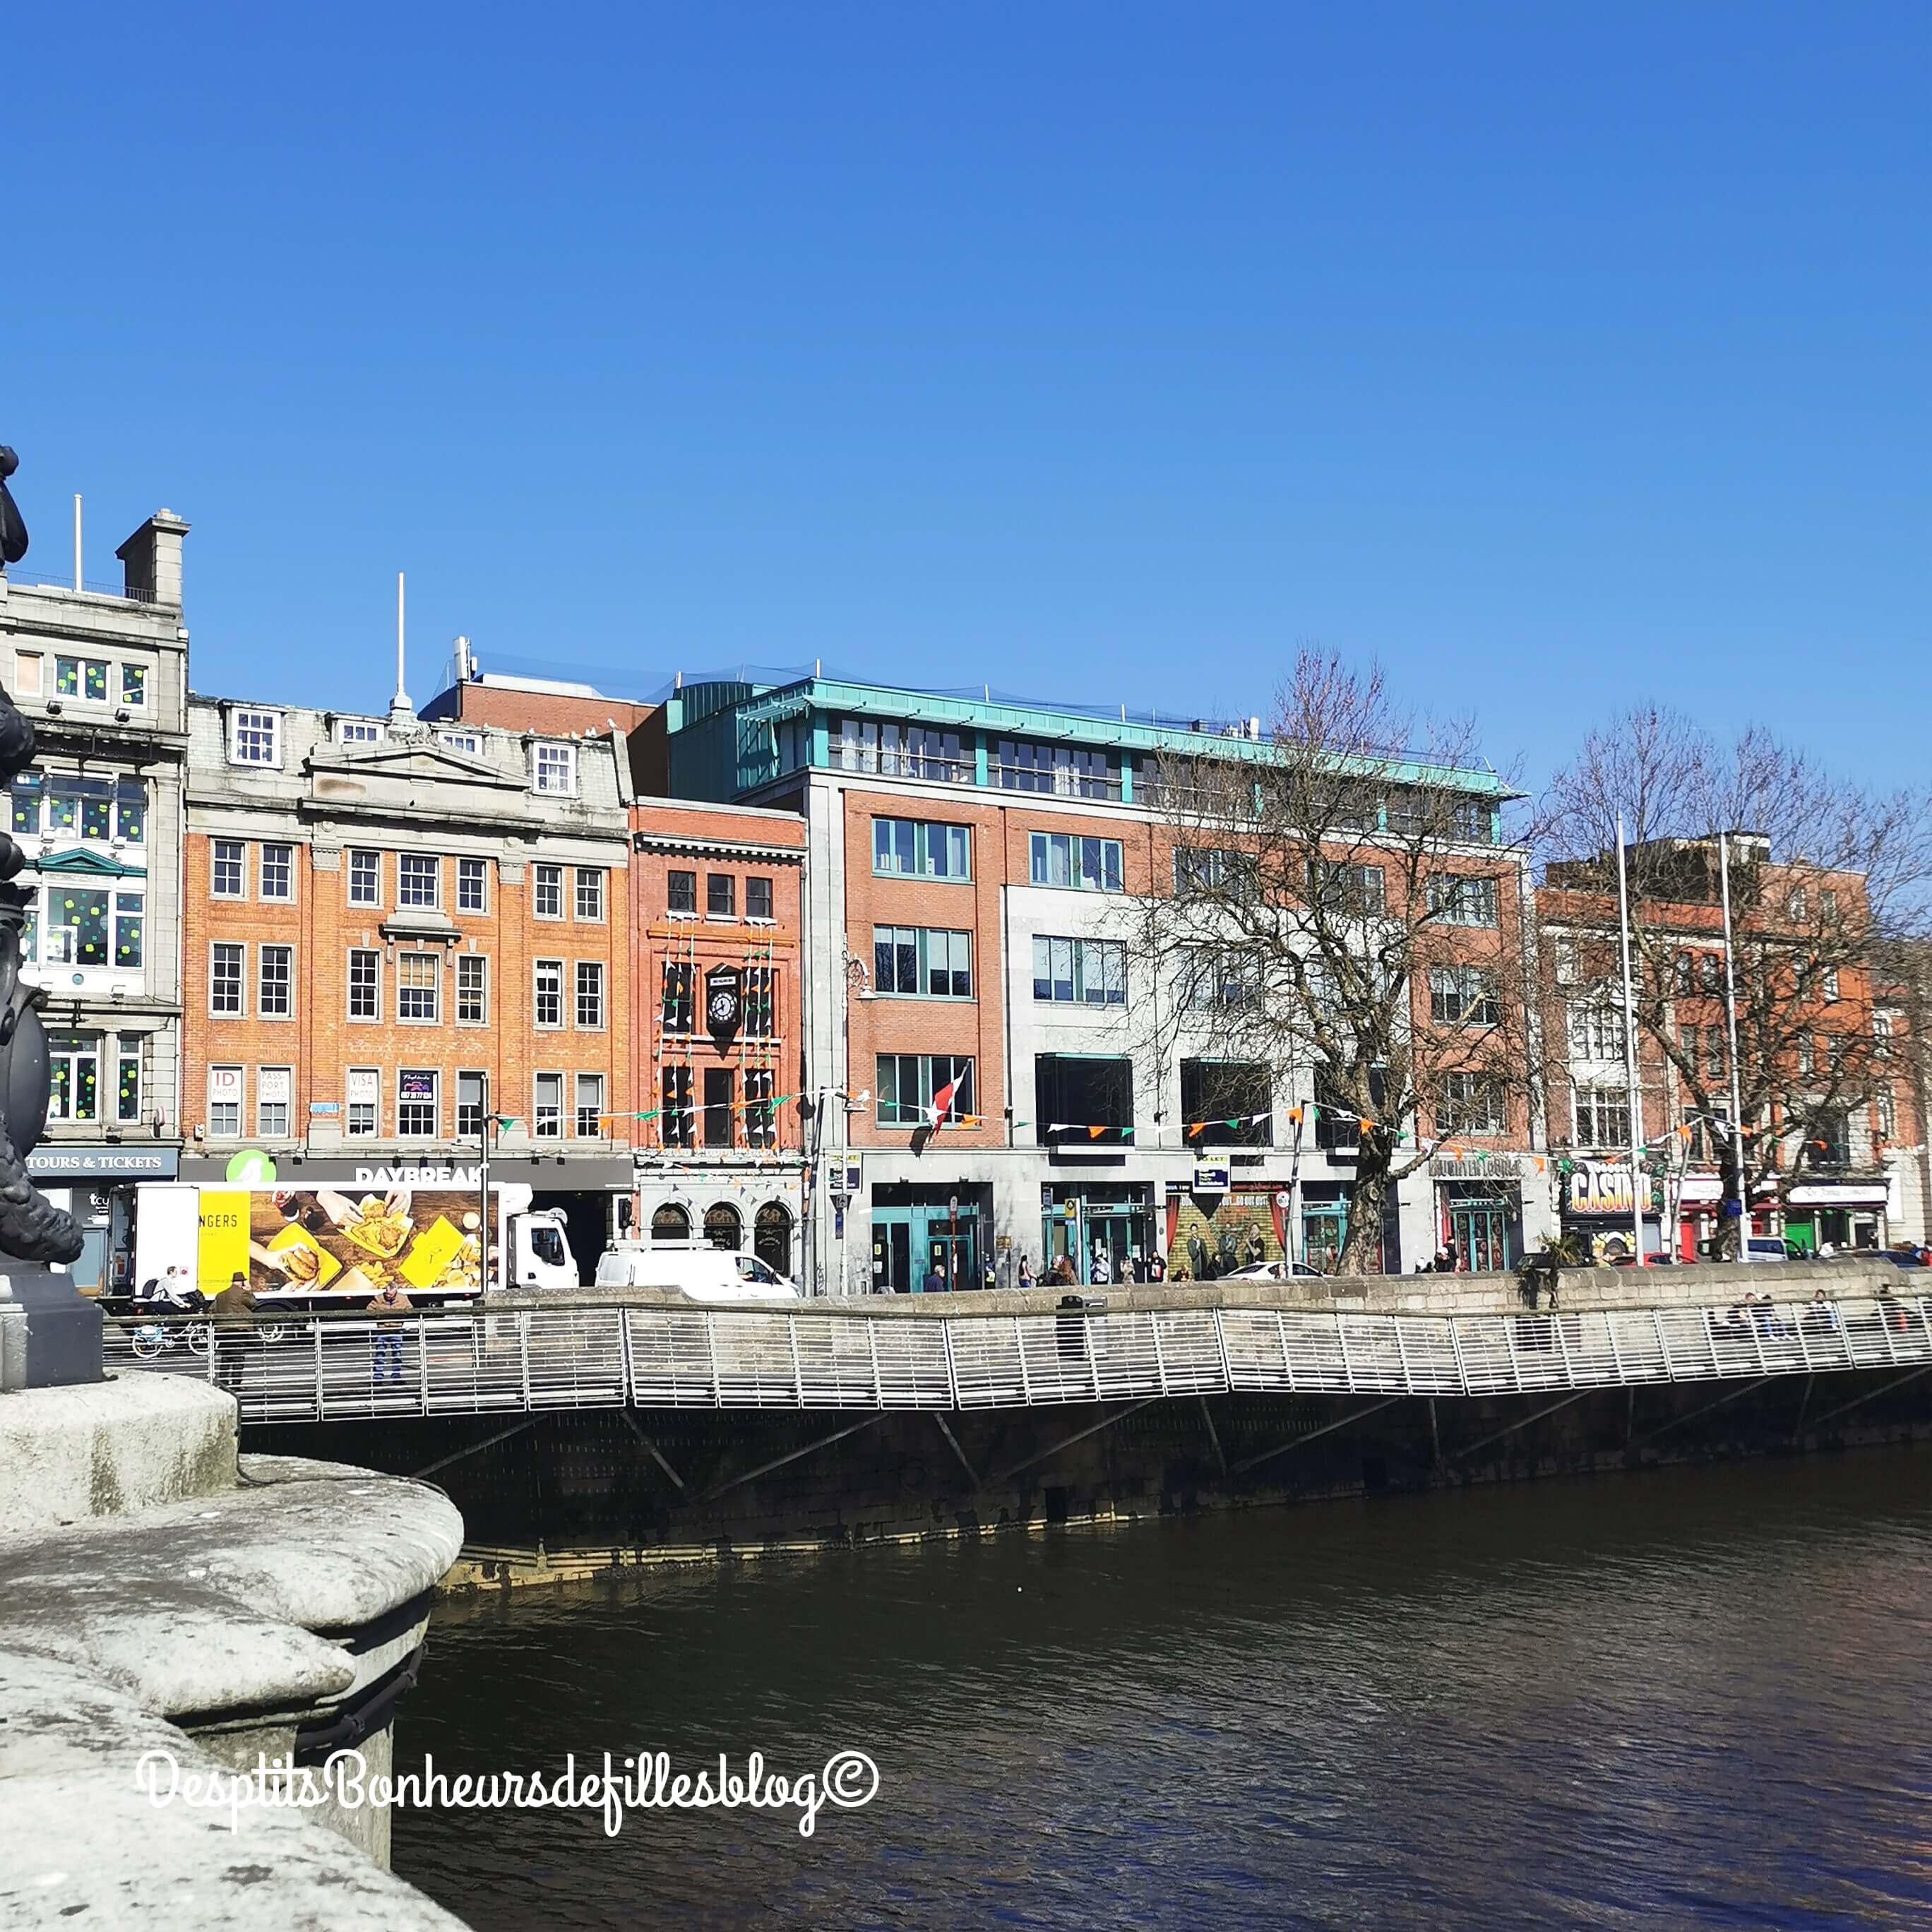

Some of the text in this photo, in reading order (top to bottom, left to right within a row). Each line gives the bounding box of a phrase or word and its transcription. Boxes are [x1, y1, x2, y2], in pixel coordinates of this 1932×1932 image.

[215, 1073, 235, 1086] ID
[261, 1072, 286, 1080] PASS-
[351, 1073, 374, 1087] VISA
[261, 1081, 285, 1090] PORT
[213, 1088, 238, 1097] PHOTO
[25, 1157, 162, 1169] TOURS & TICKETS
[355, 1167, 482, 1182] DAYBREAK
[1570, 1172, 1652, 1212] CASINO
[198, 1215, 237, 1228] NGERS
